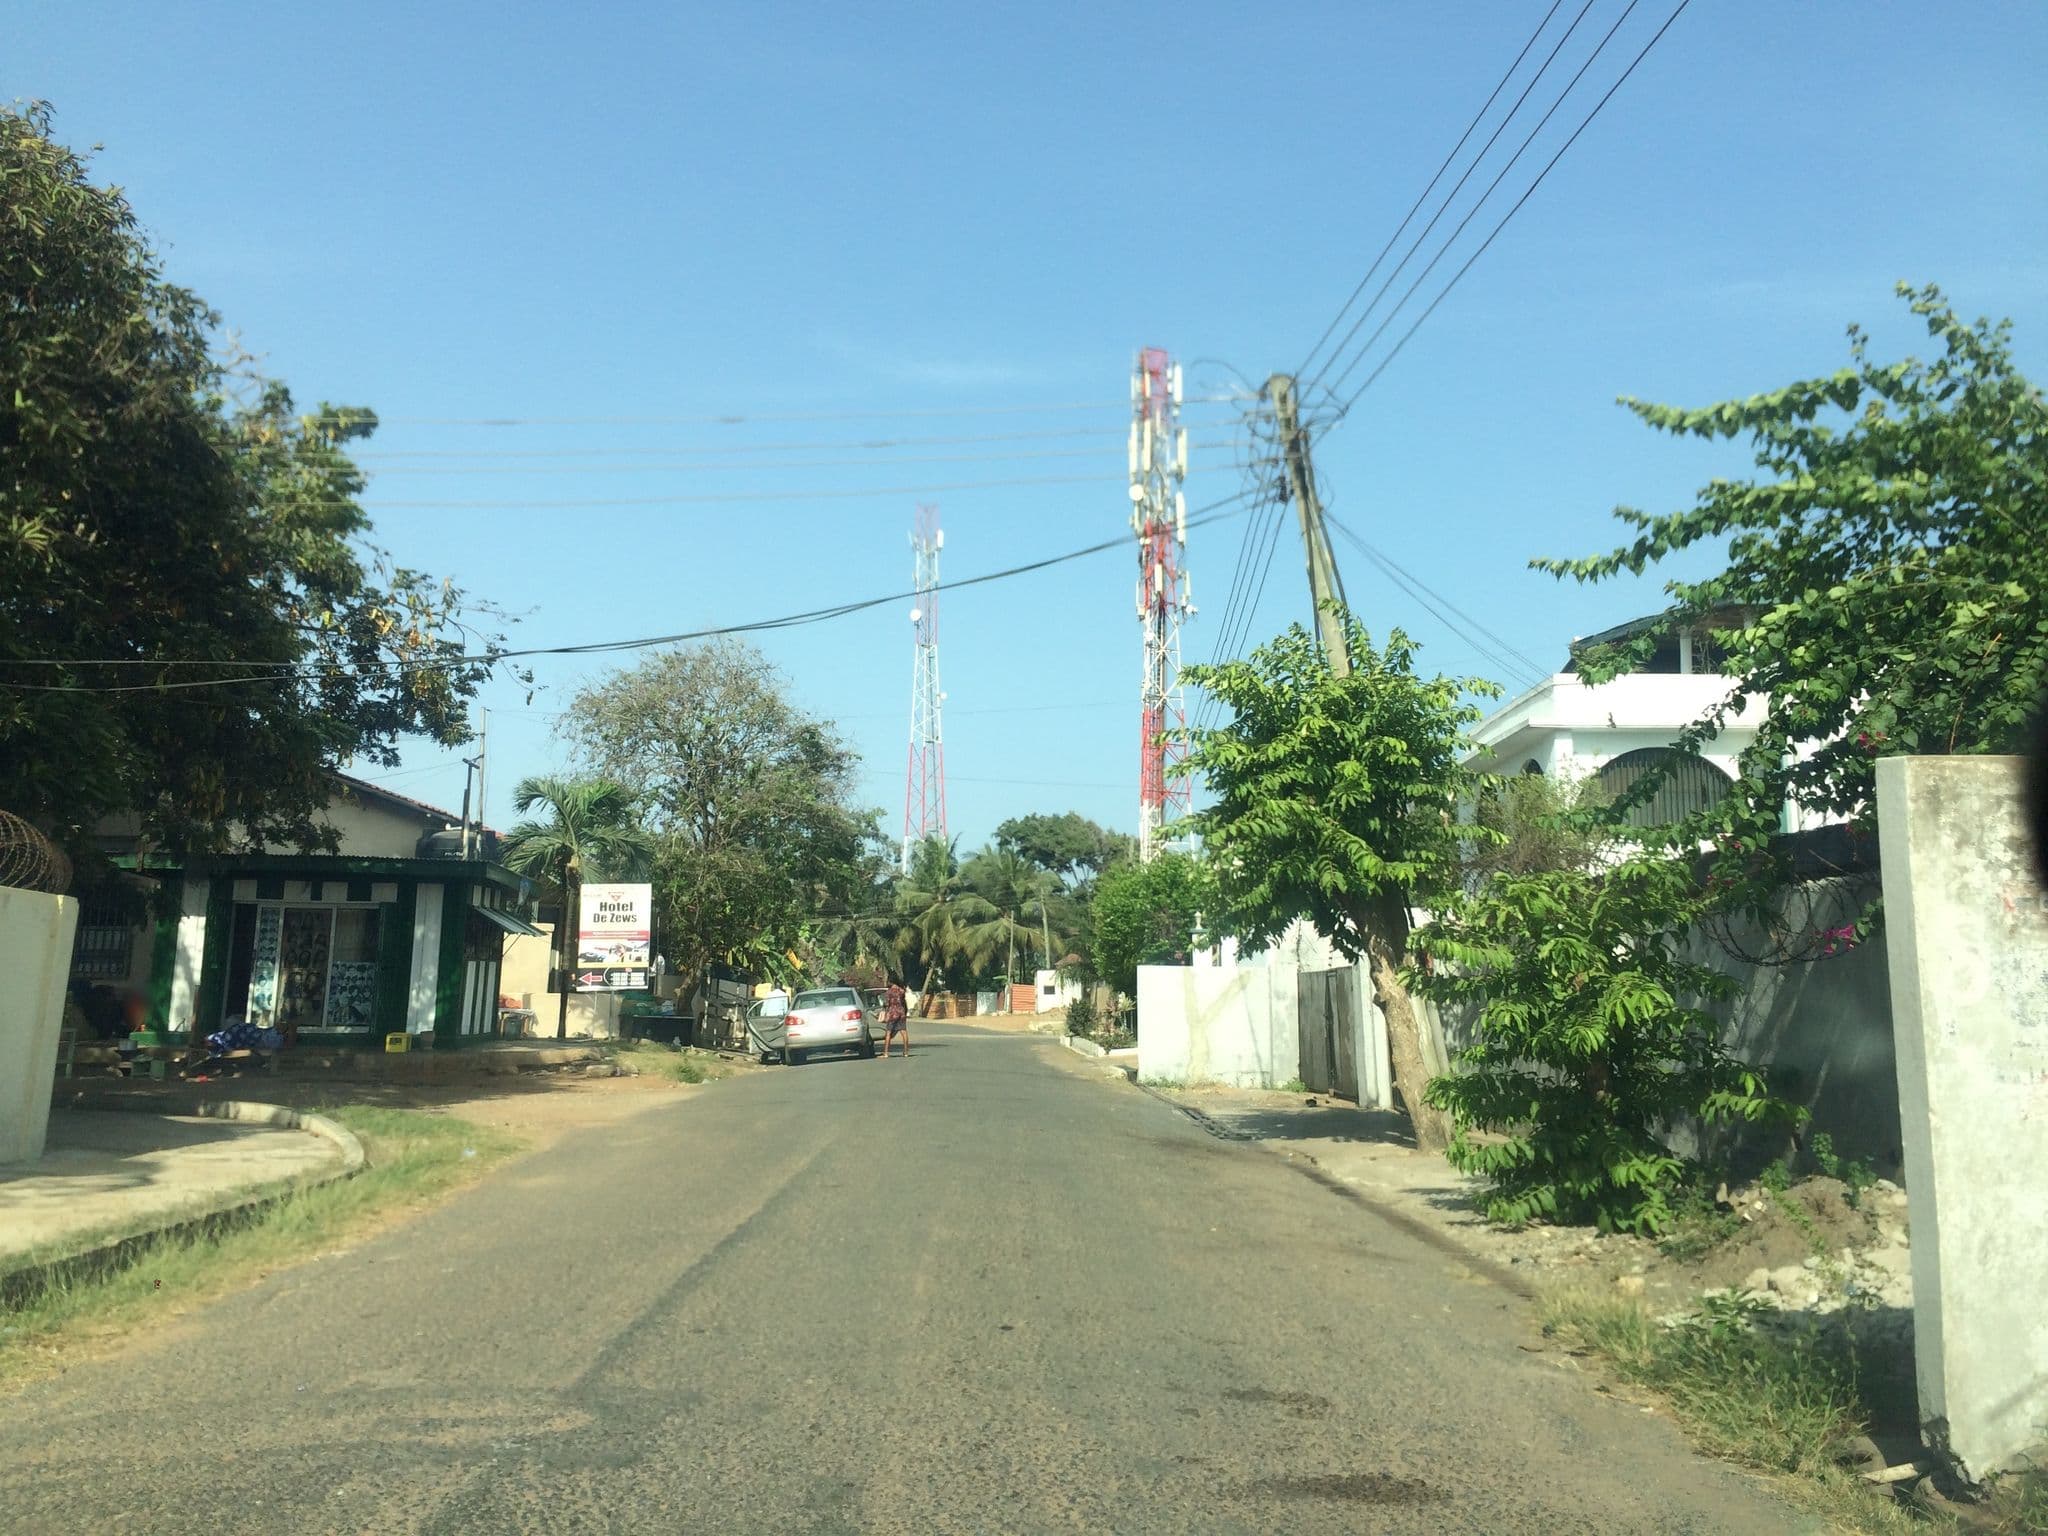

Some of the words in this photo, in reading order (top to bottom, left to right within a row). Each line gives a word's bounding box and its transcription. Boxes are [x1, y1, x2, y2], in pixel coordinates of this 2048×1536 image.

[600, 901, 633, 912] Hotel
[593, 913, 607, 923] De
[610, 913, 638, 923] Zews
